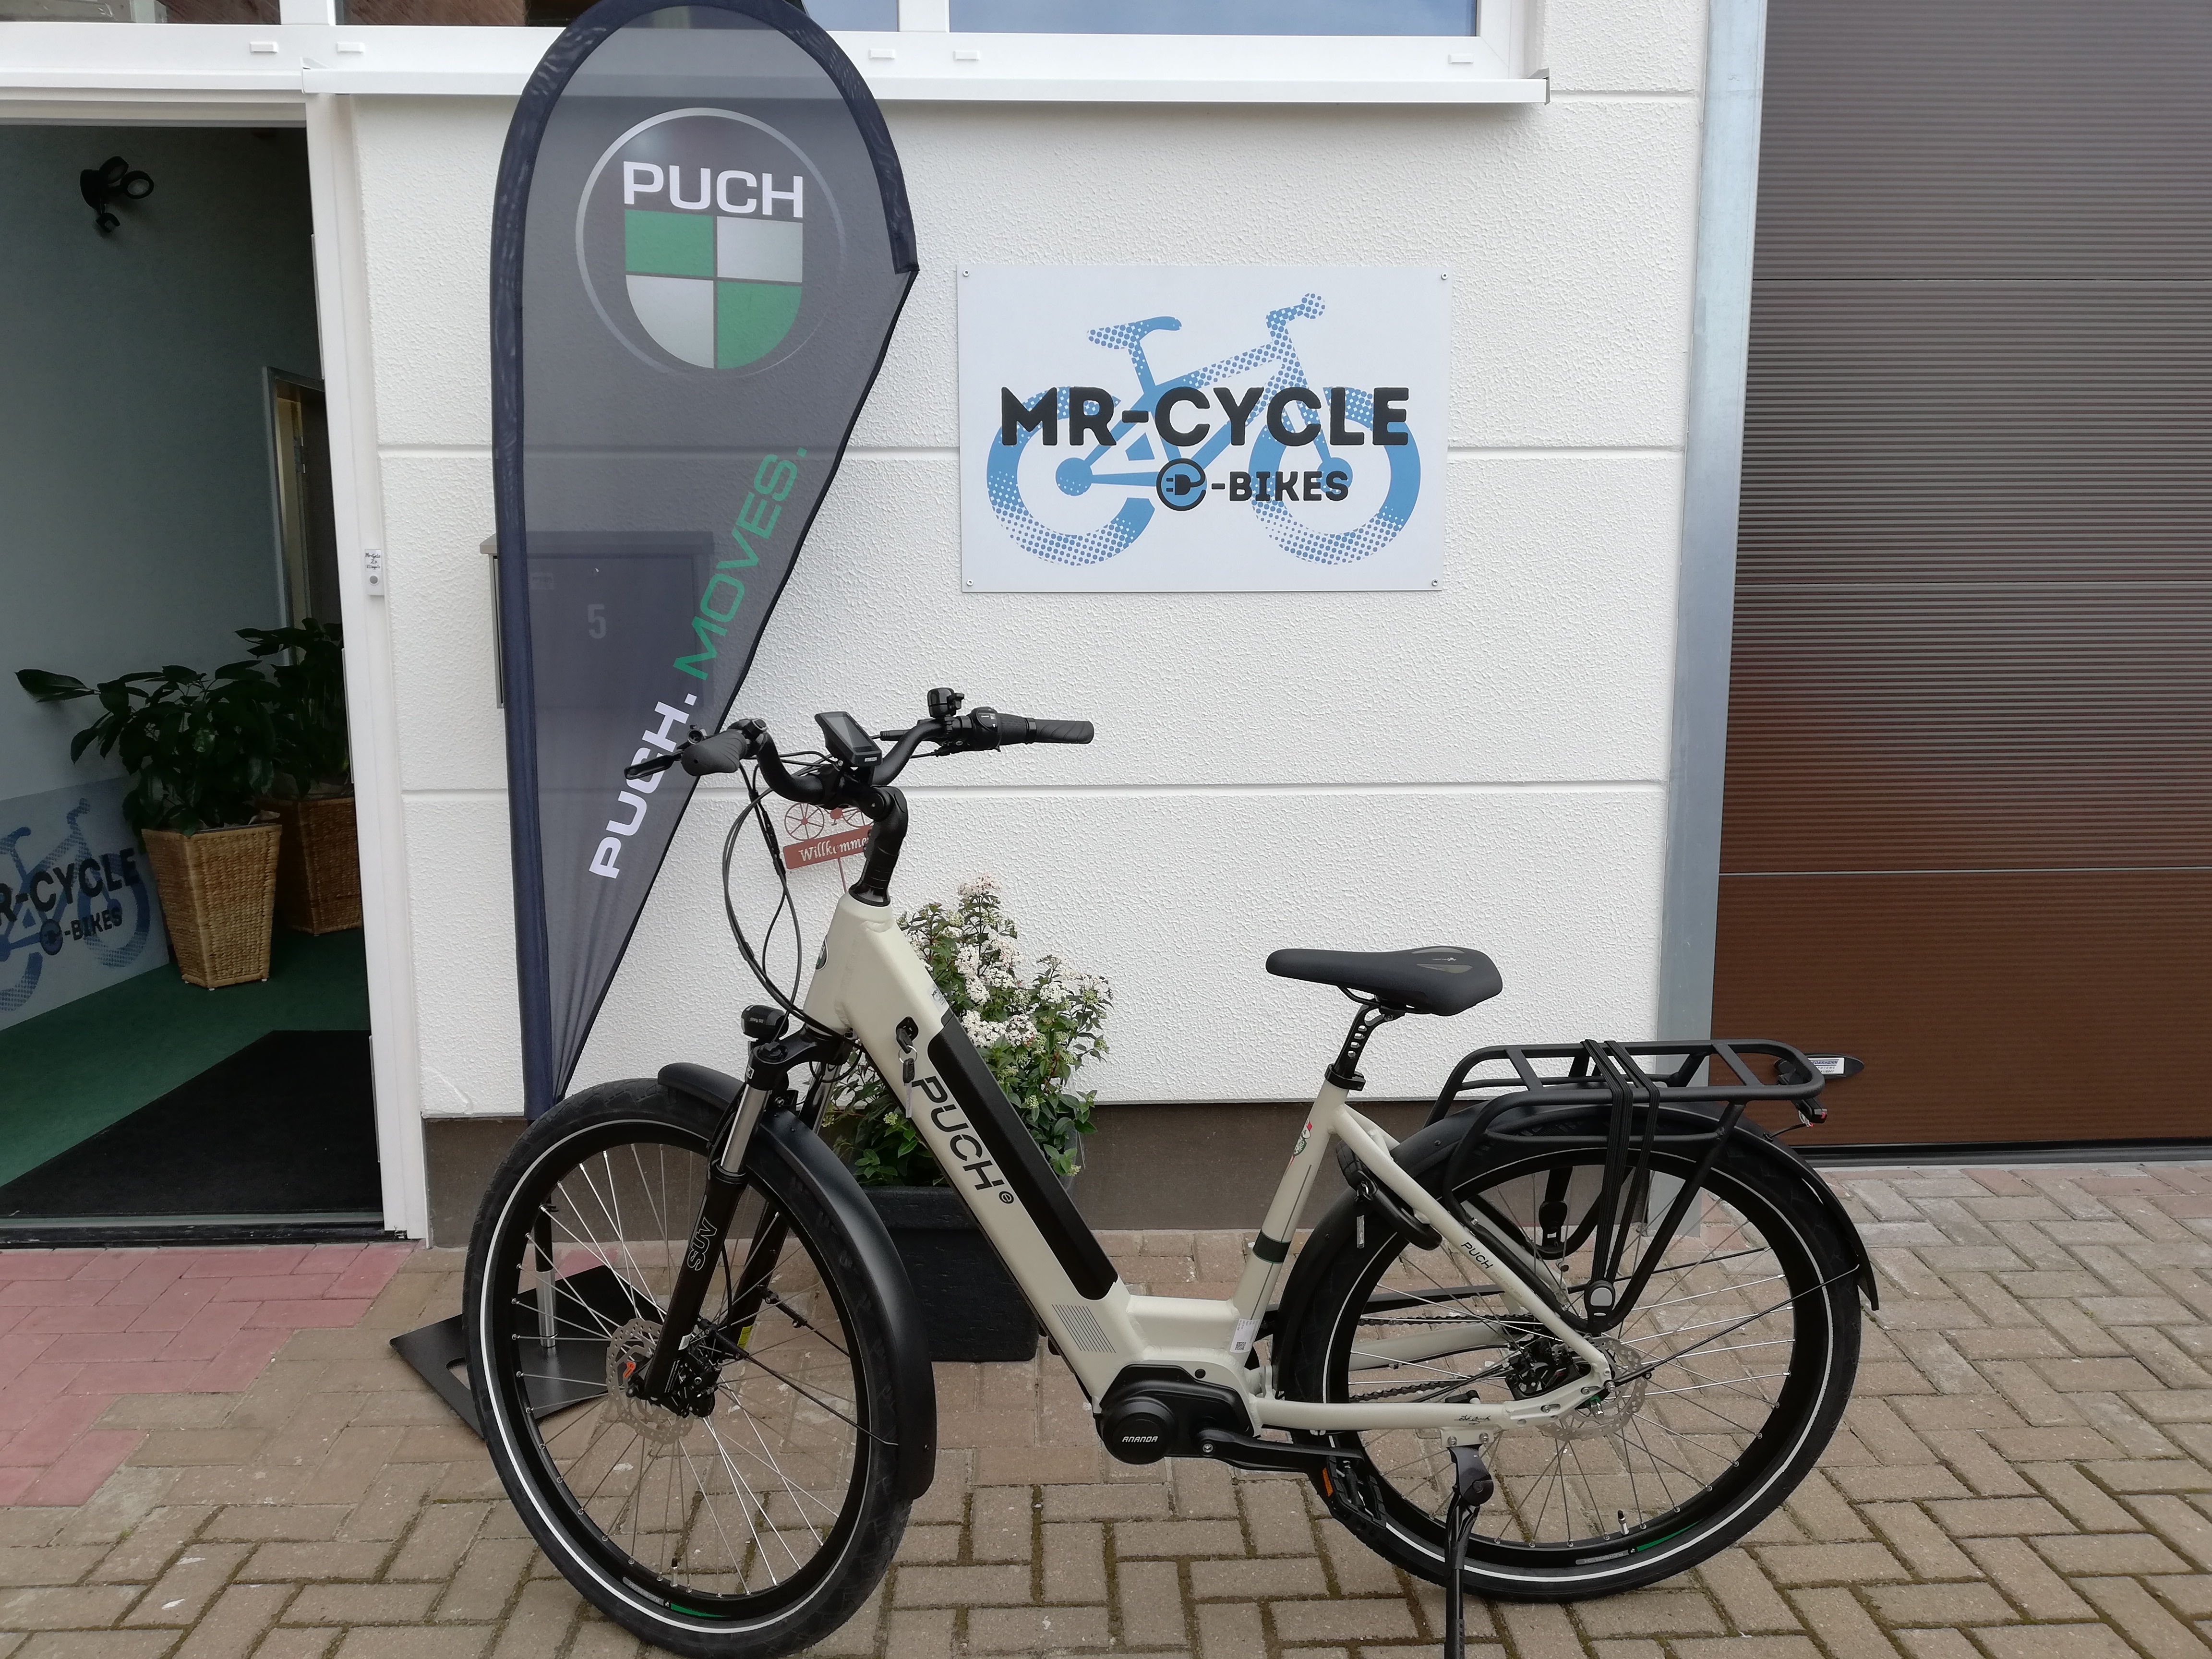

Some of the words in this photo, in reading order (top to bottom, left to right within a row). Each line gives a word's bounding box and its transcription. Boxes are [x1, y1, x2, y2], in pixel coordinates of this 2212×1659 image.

[624, 161, 803, 218] PUCH
[1001, 386, 1409, 446] MR-CYCLE
[673, 446, 807, 681] MOVES.
[587, 603, 606, 639] 5
[798, 837, 869, 862] Willkmme
[912, 1076, 1005, 1190] PUCH
[687, 1216, 718, 1271] SUV
[1461, 1242, 1493, 1269] PUCH
